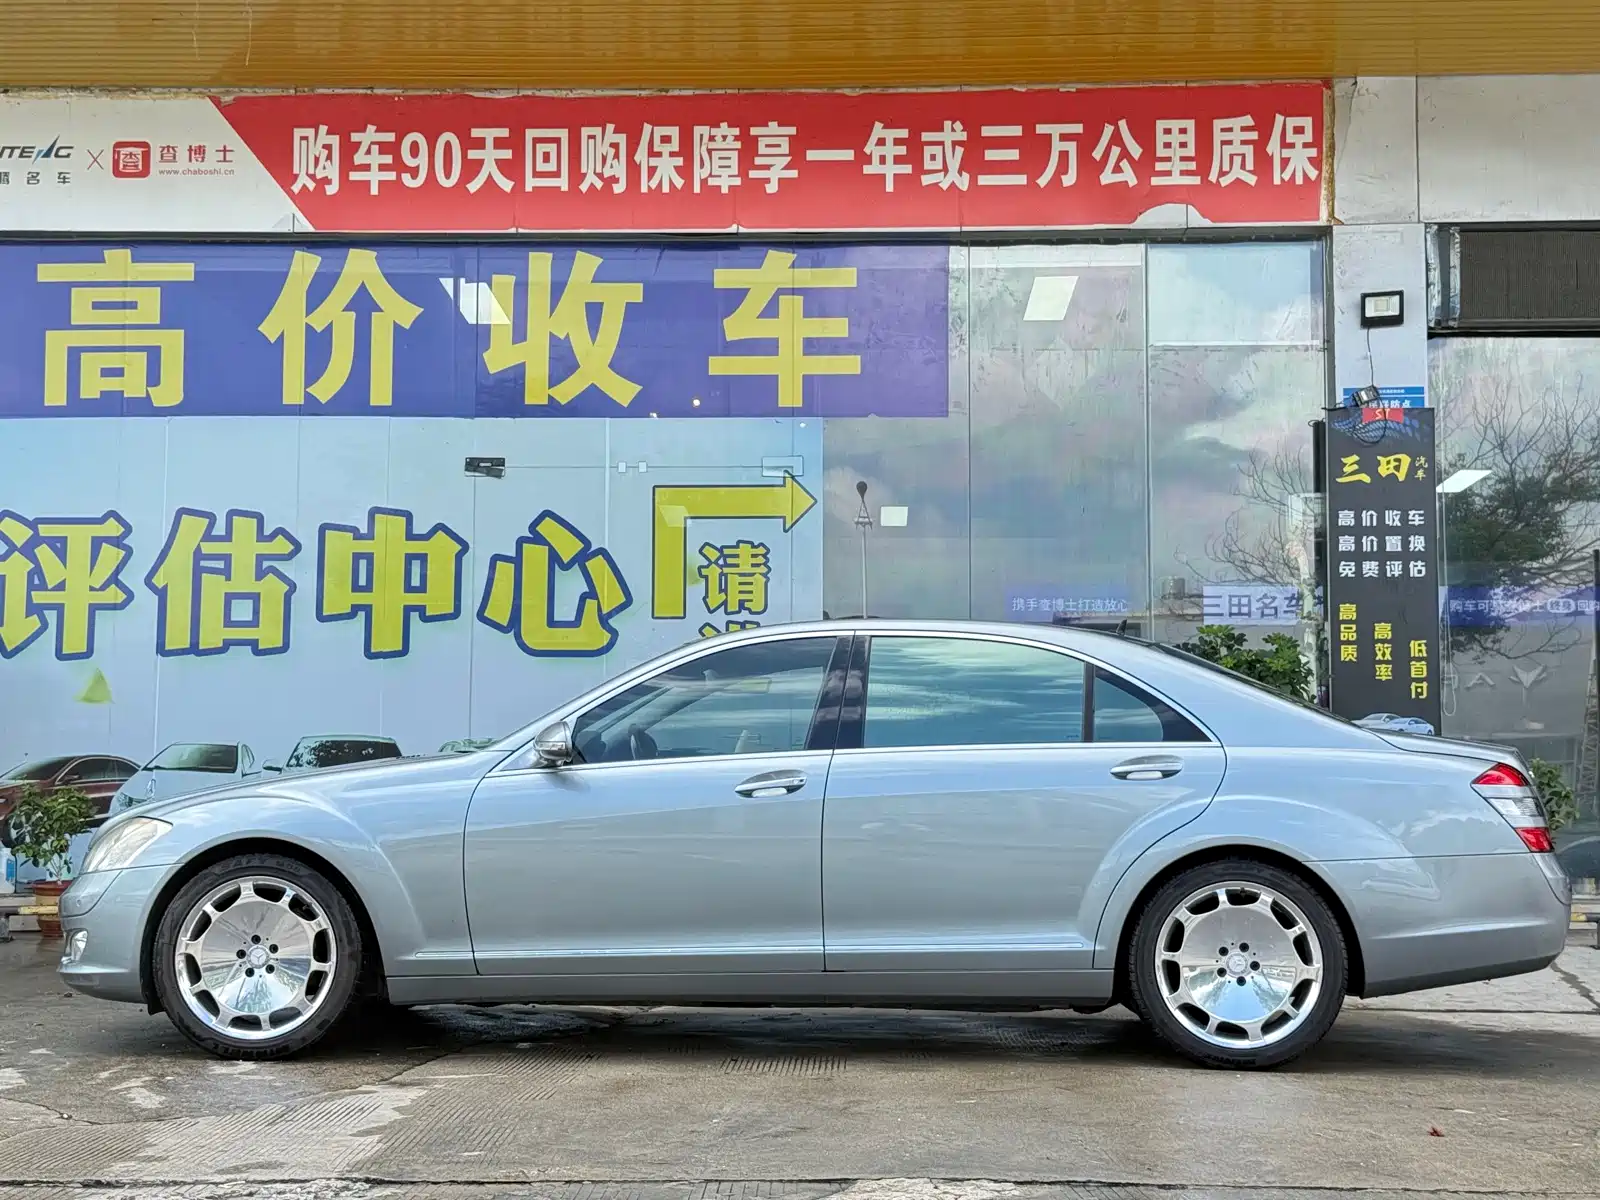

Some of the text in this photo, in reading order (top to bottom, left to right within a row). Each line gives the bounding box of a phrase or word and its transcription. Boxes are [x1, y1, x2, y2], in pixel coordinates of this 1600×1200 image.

[158, 144, 235, 163] 查博士
[158, 167, 235, 176] www.chaboshi.cn
[291, 113, 1320, 197] 购车90天回购保障享一年或三万公里质保
[37, 248, 862, 408] 高价收车
[1335, 453, 1411, 484] 三田
[1414, 455, 1428, 481] 汽车
[1338, 510, 1425, 527] 高价收车
[1338, 535, 1426, 552] 高价置换
[0, 507, 633, 661] 评估中心
[697, 539, 772, 638] 请
[1339, 561, 1426, 577] 免费评估
[1339, 603, 1357, 662] 高品质
[1374, 622, 1393, 681] 高效率
[1409, 640, 1428, 699] 低首付
